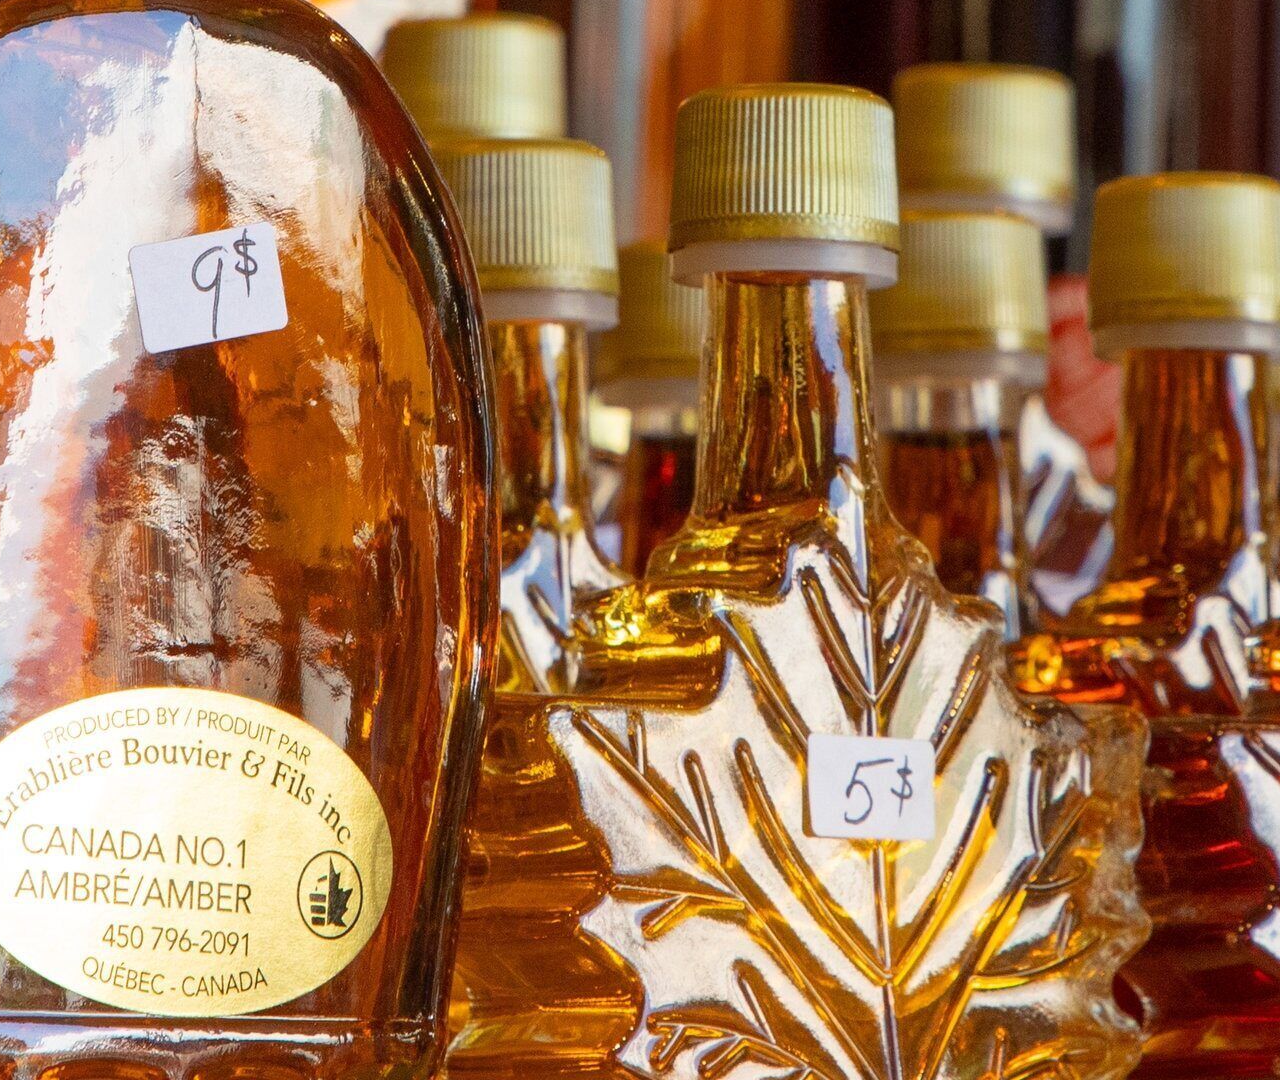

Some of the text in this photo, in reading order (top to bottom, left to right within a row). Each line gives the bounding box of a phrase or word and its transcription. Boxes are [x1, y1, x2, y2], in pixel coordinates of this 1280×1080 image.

[191, 228, 259, 340] 9$
[42, 706, 151, 748] PRODUCED
[155, 706, 182, 727] BY
[196, 710, 277, 747] PRODUIT
[277, 734, 312, 767] PAR
[121, 737, 233, 772] Bouvier
[240, 749, 267, 780] &
[269, 761, 317, 807] Fils
[317, 792, 353, 846] inc
[843, 755, 914, 826] 5$
[21, 824, 249, 870] CANADA NO.1
[14, 867, 253, 916] AMBRÉ/AMBER
[101, 923, 251, 958] 450 796-2091
[81, 955, 166, 998] QUÉBEC
[180, 966, 269, 999] CANADA
